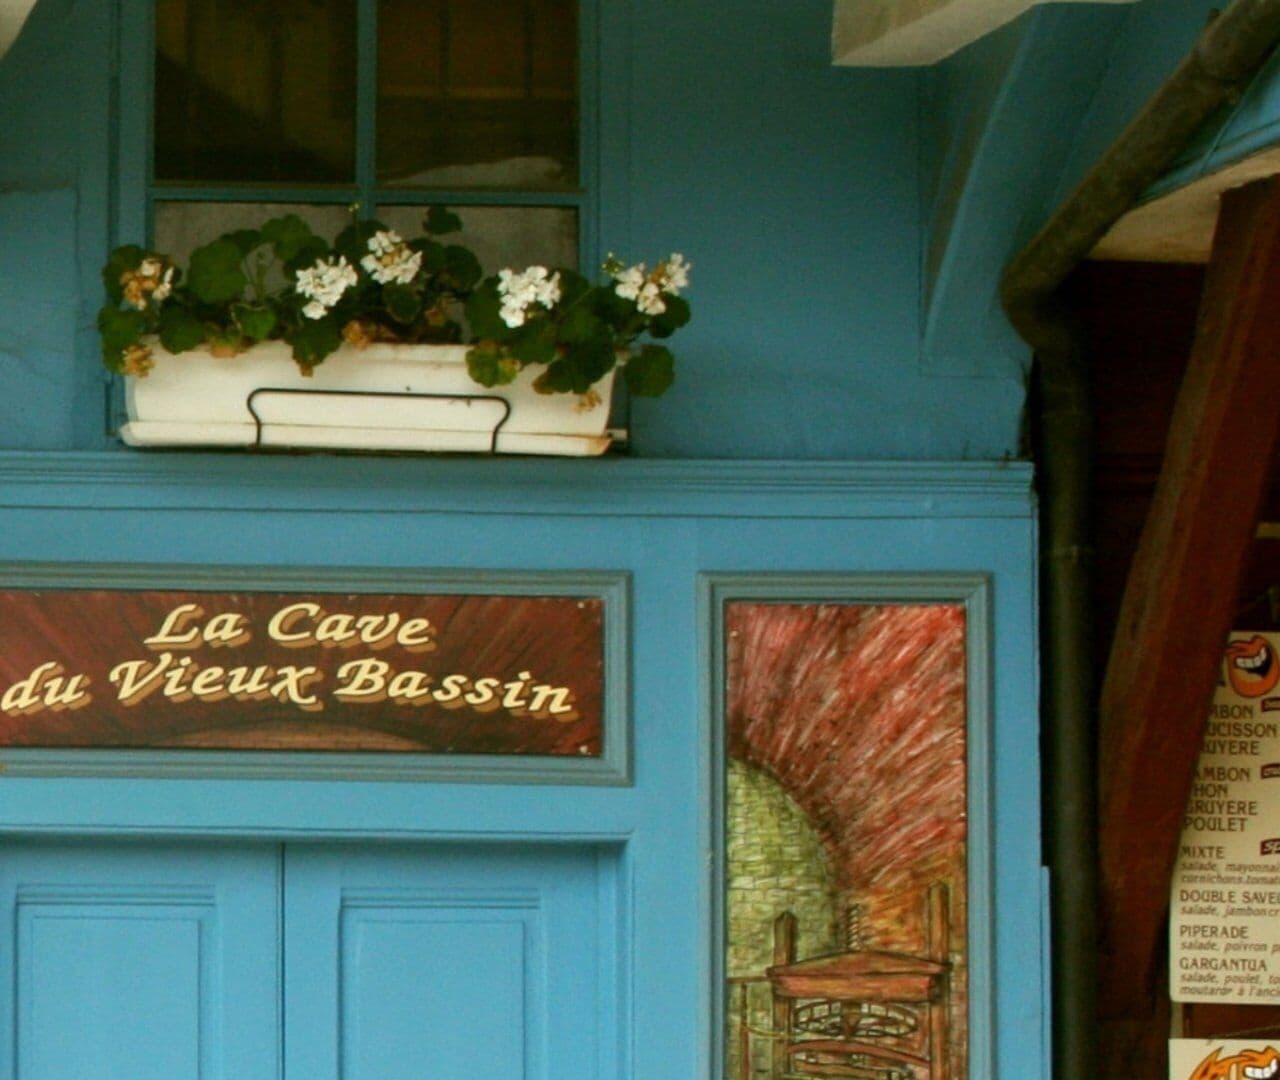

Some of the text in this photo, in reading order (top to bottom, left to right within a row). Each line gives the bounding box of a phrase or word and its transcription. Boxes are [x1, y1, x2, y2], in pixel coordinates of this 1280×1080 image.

[142, 602, 433, 647] La Cave
[0, 652, 574, 714] du Vieux Bassin
[1204, 720, 1278, 738] UCISSON
[1204, 739, 1261, 755] UYERE
[1183, 816, 1249, 832] POULET
[1181, 846, 1225, 860] MIXTE
[1180, 889, 1280, 904] DOUBLE SAVE
[1180, 924, 1249, 939] PIPERADE
[1179, 956, 1268, 972] GARGANTUA
